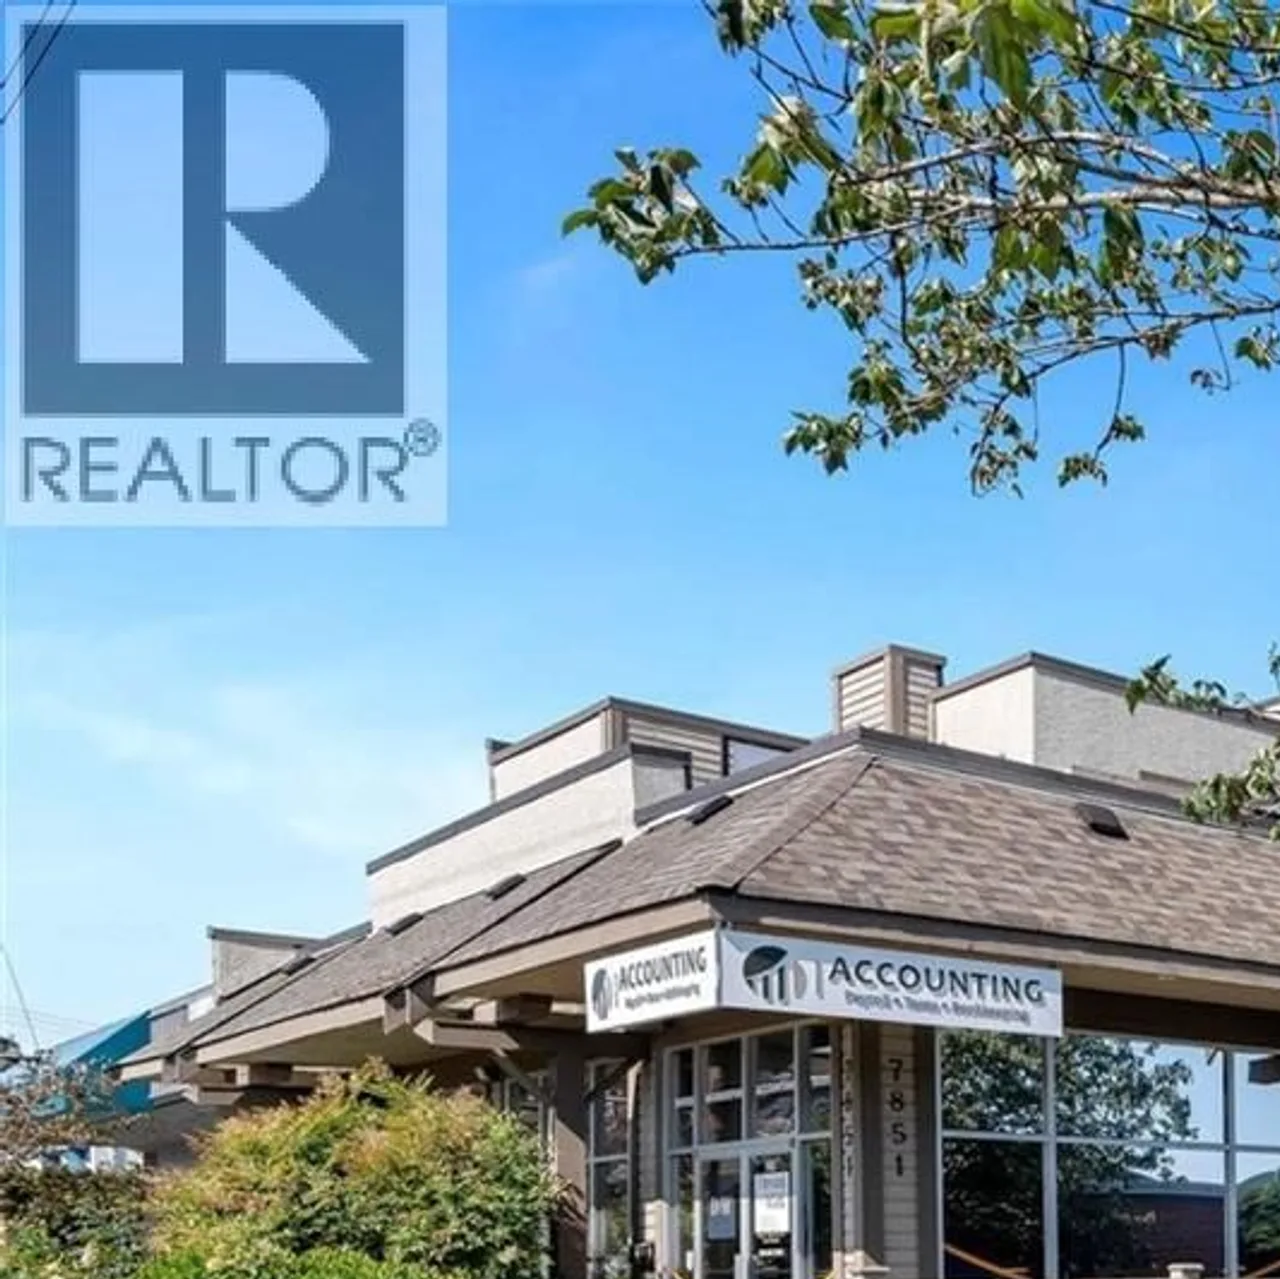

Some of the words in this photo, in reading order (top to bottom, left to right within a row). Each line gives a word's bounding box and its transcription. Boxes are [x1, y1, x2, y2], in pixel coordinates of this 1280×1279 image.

[619, 946, 707, 991] ACCOUNTING
[829, 956, 1045, 1003] ACCOUNTING
[888, 1057, 907, 1177] 7851
